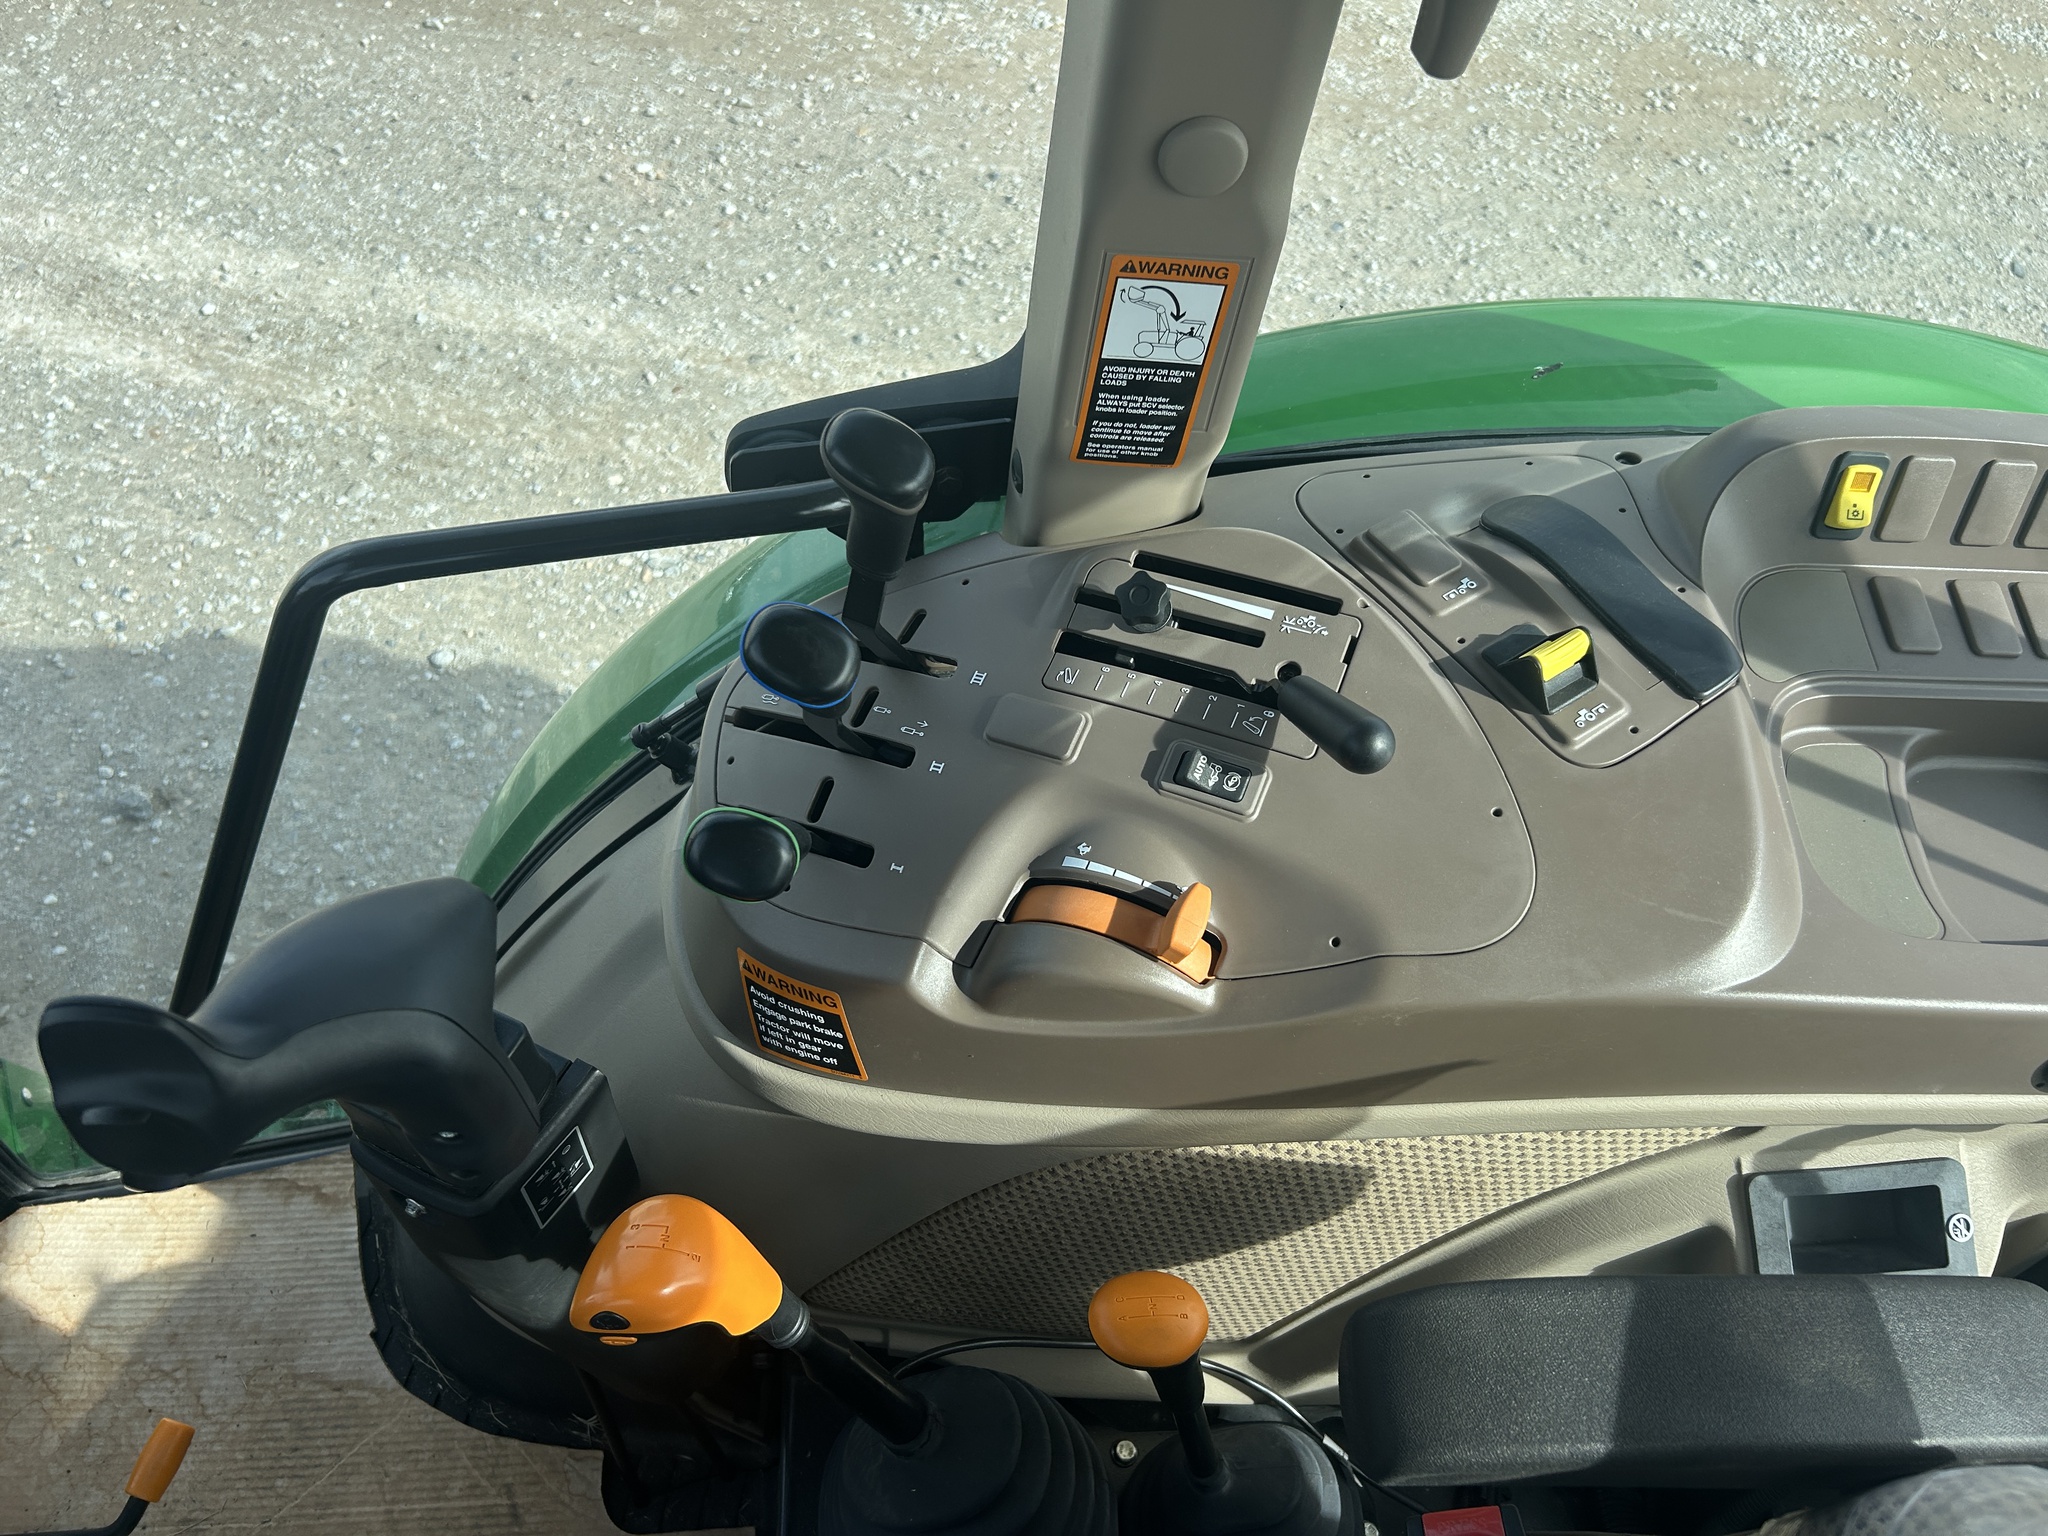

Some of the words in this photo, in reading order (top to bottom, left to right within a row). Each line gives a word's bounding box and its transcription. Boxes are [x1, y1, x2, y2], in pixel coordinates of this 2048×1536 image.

[1139, 261, 1229, 280] WARNING
[1148, 375, 1182, 383] FALLING
[970, 670, 987, 686] III
[929, 761, 946, 773] II
[1193, 756, 1207, 780] AUTO
[752, 964, 838, 1009] WARNING
[750, 986, 775, 1004] Avoid
[778, 1001, 825, 1024] crushing
[753, 999, 787, 1022] Engage
[789, 1017, 812, 1030] park
[813, 1025, 843, 1039] brake
[756, 1013, 790, 1033] Tractor
[792, 1030, 811, 1041] will
[814, 1037, 844, 1050] move
[762, 1035, 782, 1048] with
[785, 1045, 820, 1061] engine
[823, 1056, 838, 1065] off
[768, 1027, 783, 1041] left
[785, 1034, 795, 1044] in
[798, 1040, 822, 1053] gear
